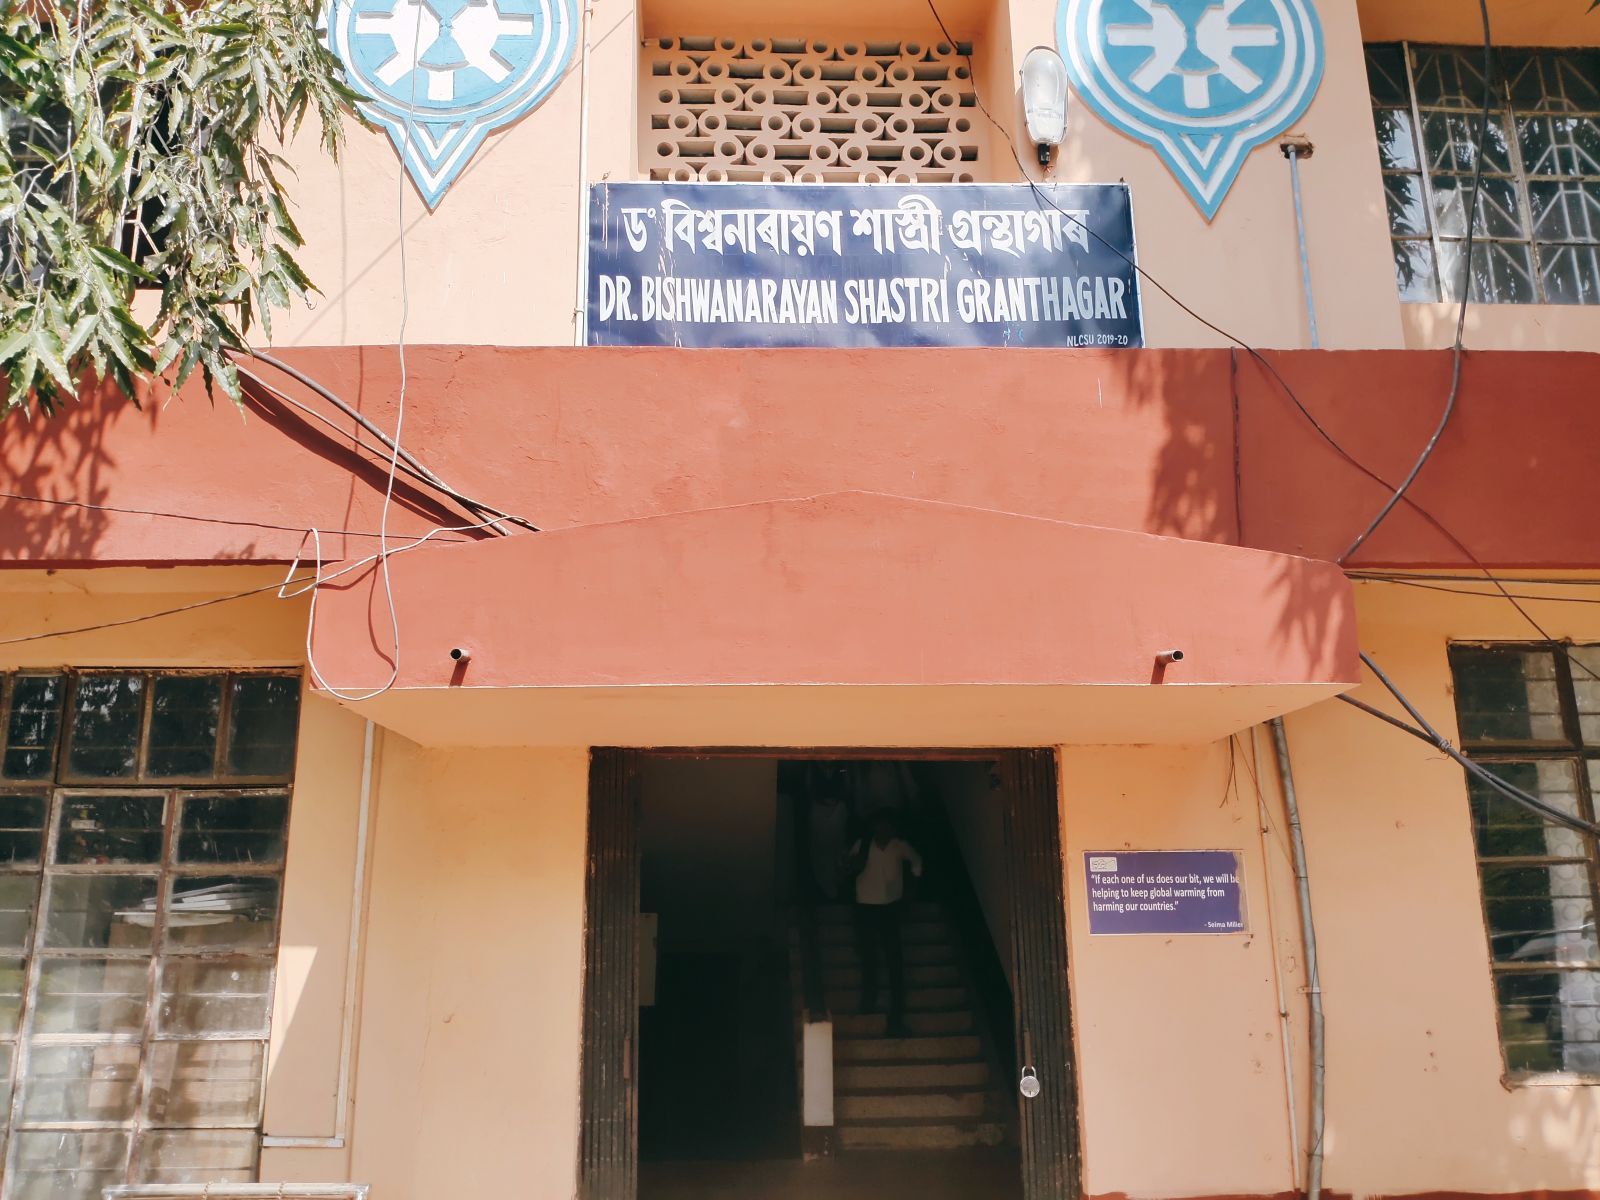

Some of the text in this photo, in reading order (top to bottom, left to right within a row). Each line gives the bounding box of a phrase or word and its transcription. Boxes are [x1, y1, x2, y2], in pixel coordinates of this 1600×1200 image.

[599, 274, 1127, 324] DR. BISHWANARAYAN SHASTRI GRANTHAGAR
[1066, 334, 1128, 347] NLCSU 2019-20
[1102, 873, 1119, 884] each
[1121, 876, 1135, 884] one
[1137, 874, 1145, 884] of
[1146, 876, 1155, 884] us
[1156, 873, 1173, 884] does
[1175, 876, 1188, 884] our
[1189, 873, 1202, 885] bit,
[1203, 876, 1214, 884] we
[1215, 873, 1229, 884] will
[1092, 887, 1225, 899] helping to keep global warming from
[1093, 901, 1124, 913] harming
[1125, 902, 1138, 911] our
